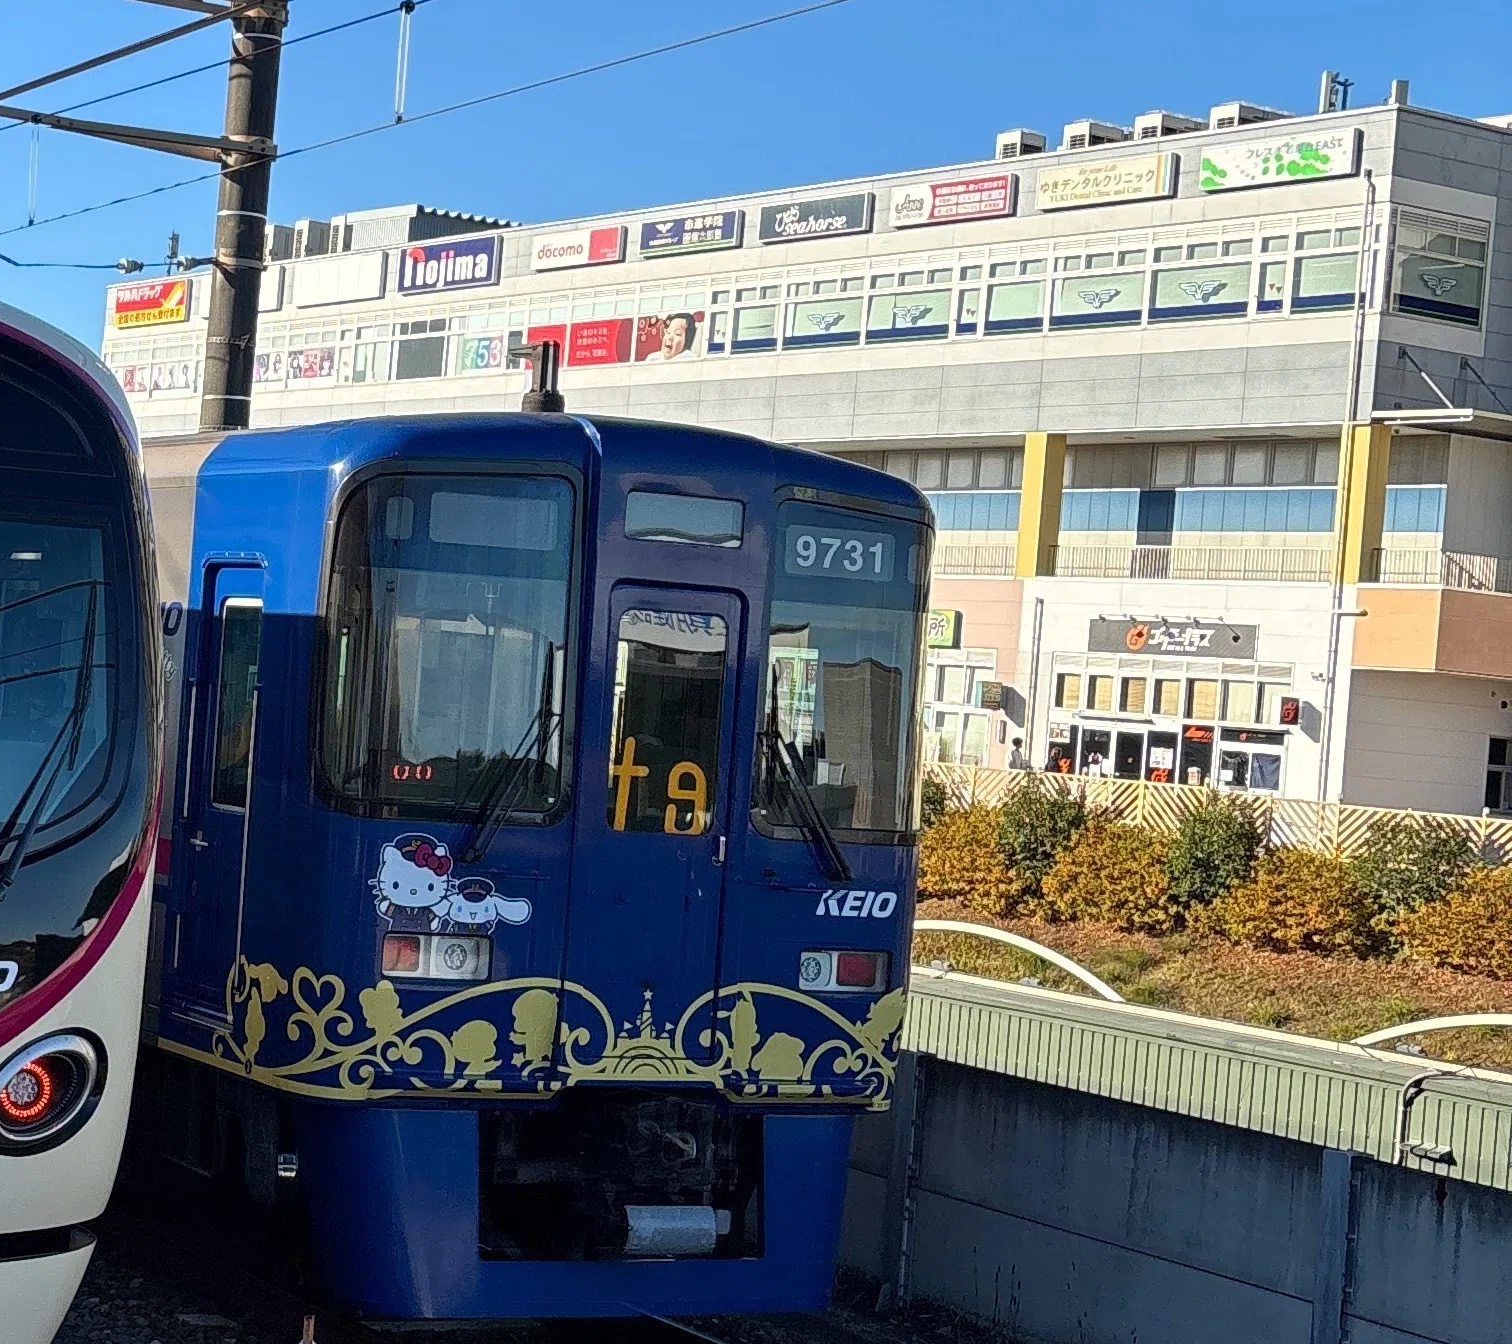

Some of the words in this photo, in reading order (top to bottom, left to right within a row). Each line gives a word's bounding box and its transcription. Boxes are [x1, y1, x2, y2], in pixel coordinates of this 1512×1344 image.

[1040, 169, 1155, 194] ゆきデンタルクリニック
[1049, 193, 1068, 203] YUKI
[1070, 190, 1091, 201] Dental
[1092, 189, 1112, 198] Clinic
[1114, 187, 1126, 196] and
[1127, 185, 1143, 194] Care
[782, 214, 847, 236] seahorse
[538, 244, 583, 259] docomo
[796, 535, 883, 574] 9731
[815, 888, 898, 919] KEIO
